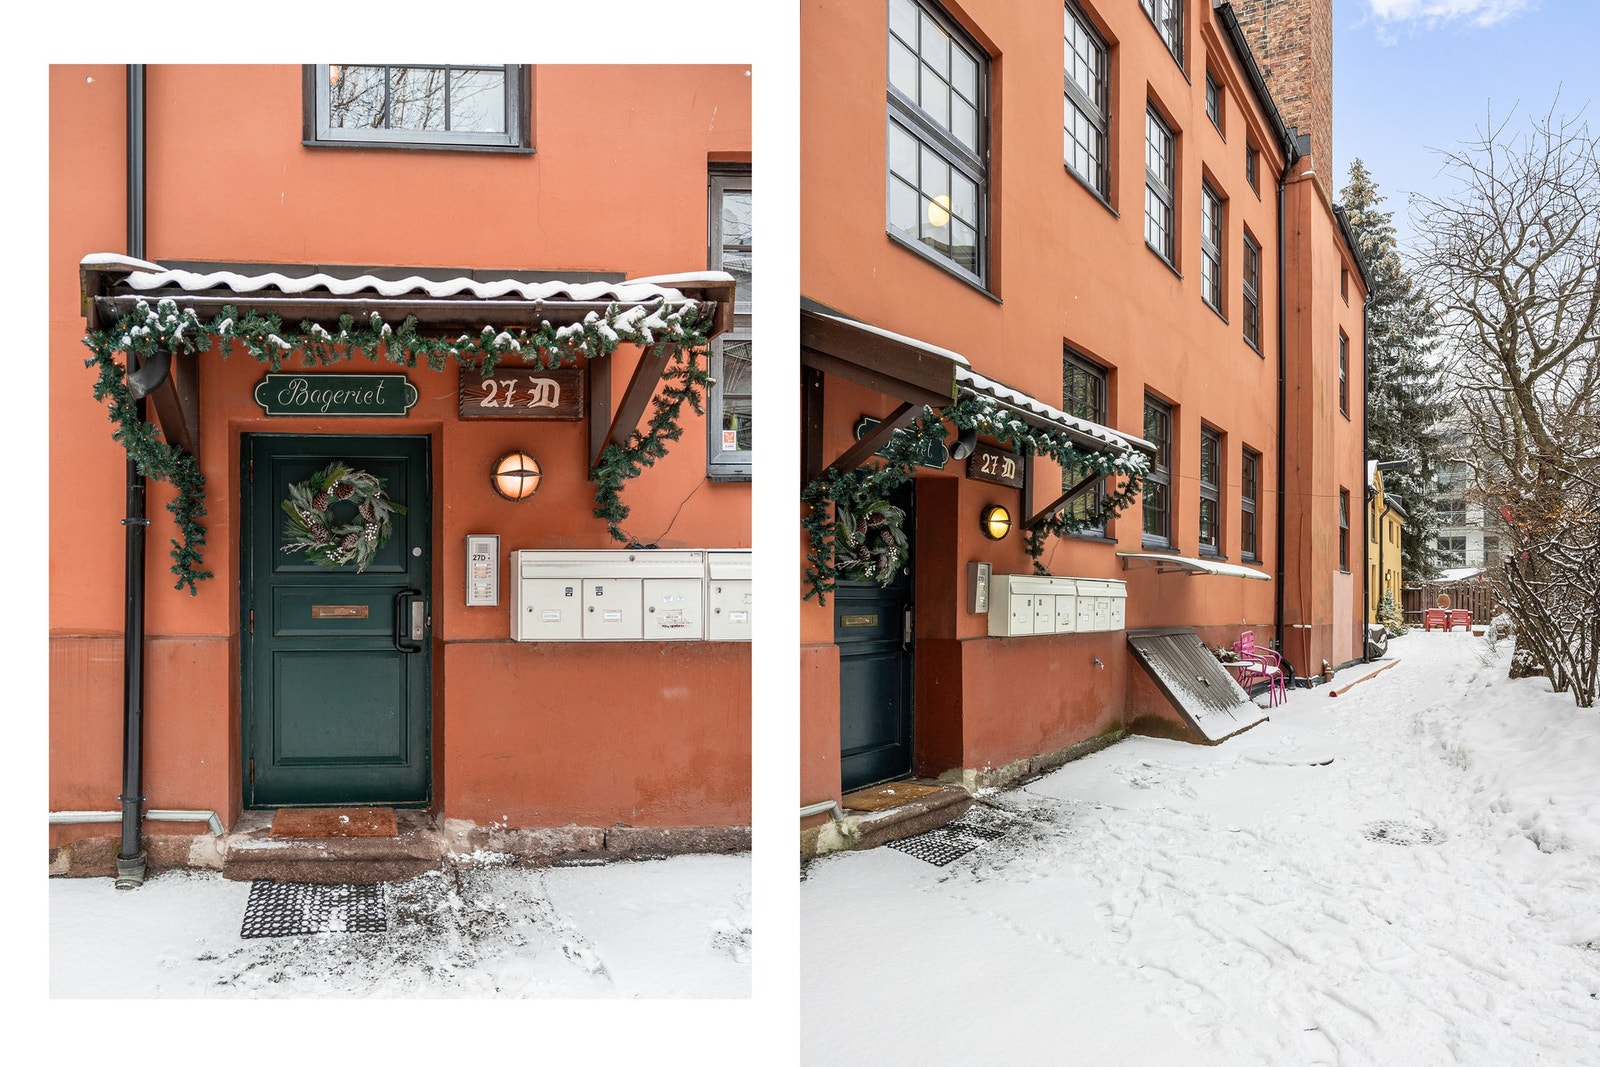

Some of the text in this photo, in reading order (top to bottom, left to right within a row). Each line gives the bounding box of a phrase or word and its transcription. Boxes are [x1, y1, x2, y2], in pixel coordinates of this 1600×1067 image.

[277, 378, 385, 413] Bageriet
[480, 376, 561, 409] 27 D
[980, 452, 999, 475] 27
